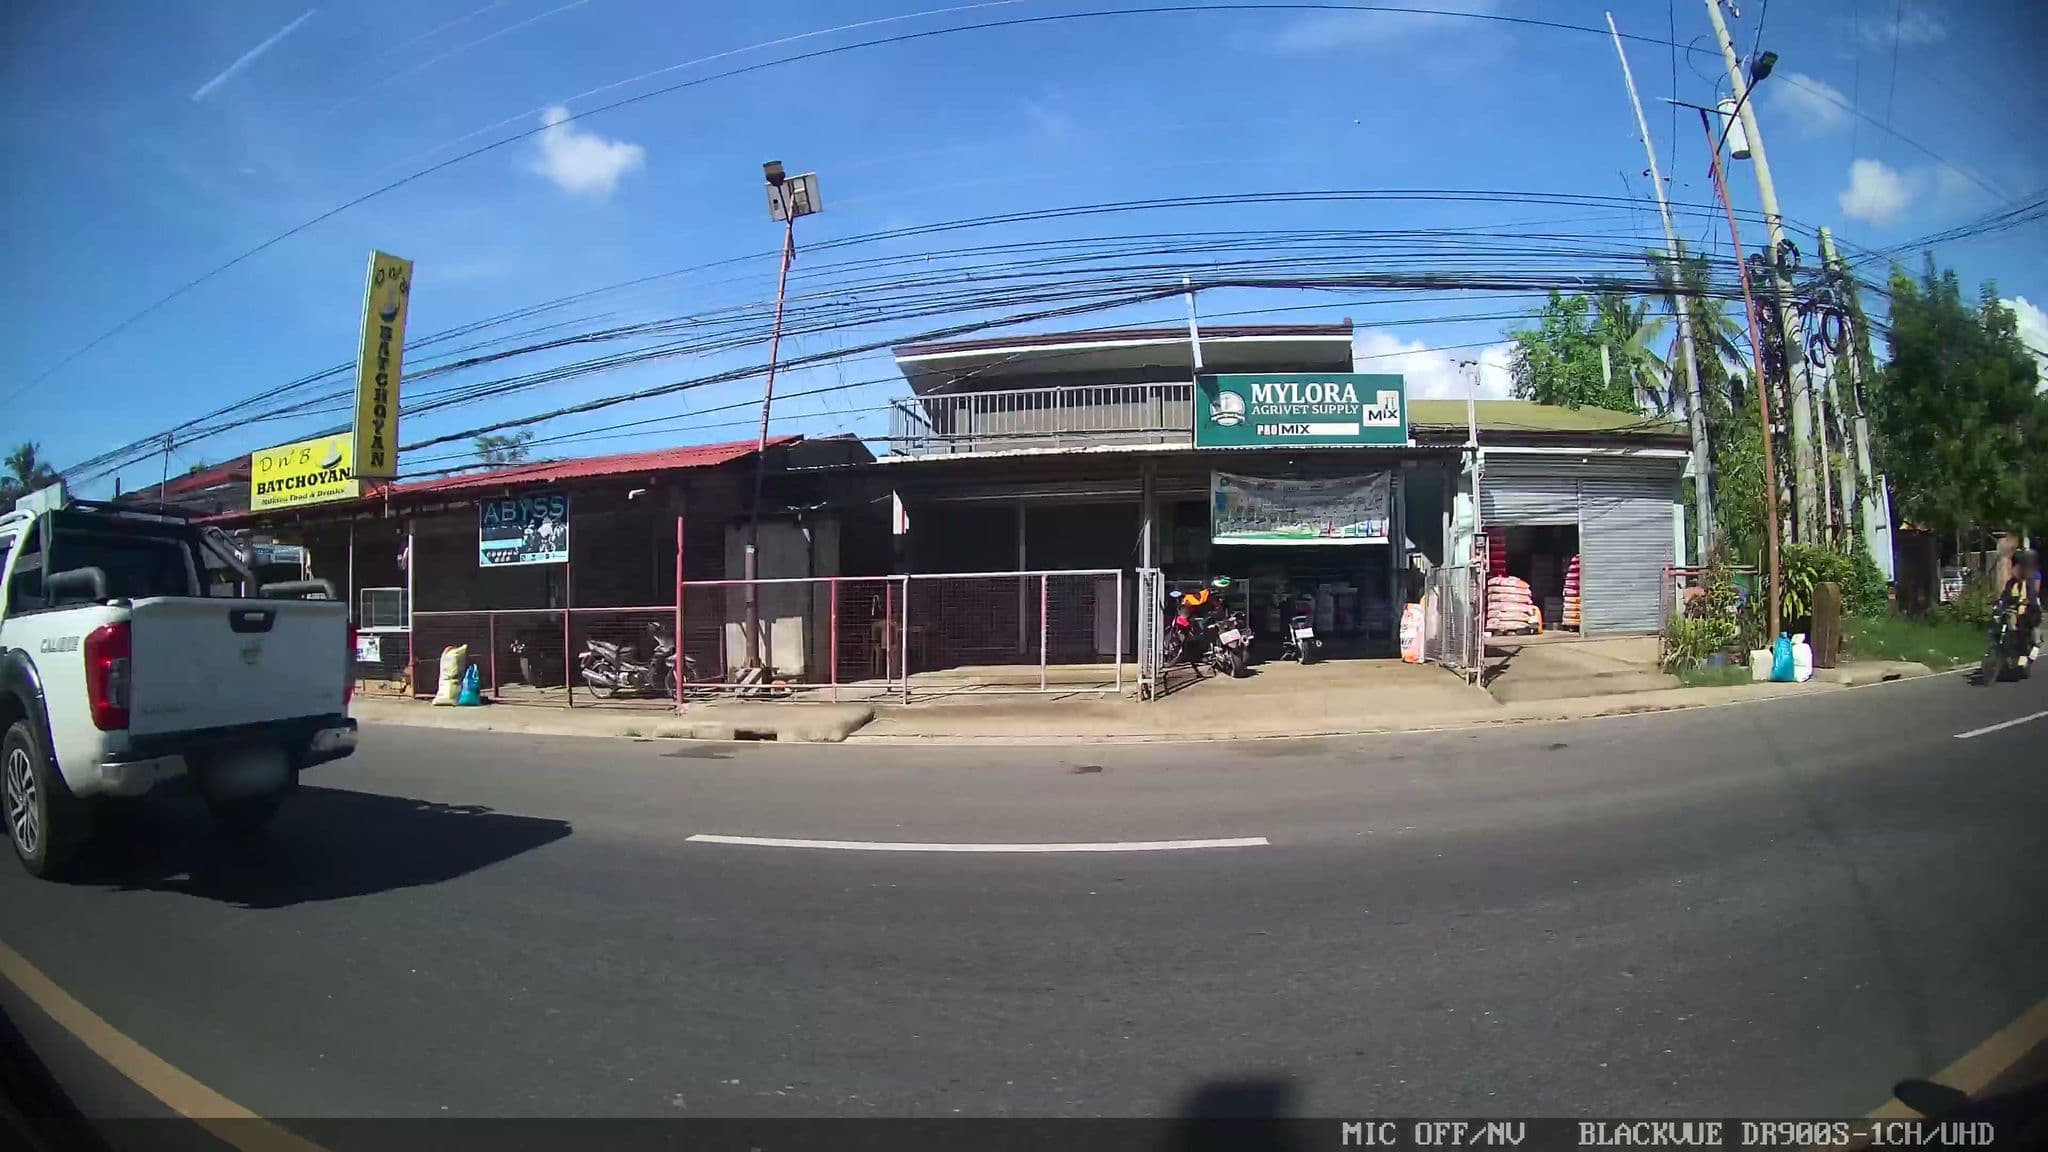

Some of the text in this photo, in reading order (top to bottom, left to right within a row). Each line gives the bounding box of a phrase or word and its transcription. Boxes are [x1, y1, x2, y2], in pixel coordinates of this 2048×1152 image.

[370, 325, 393, 468] BATCHOYAN
[1250, 382, 1359, 404] MYLORA
[1251, 404, 1360, 415] AGRIVET SUPPLY
[257, 467, 351, 495] BATCHOYAN
[484, 496, 564, 523] ABYSS
